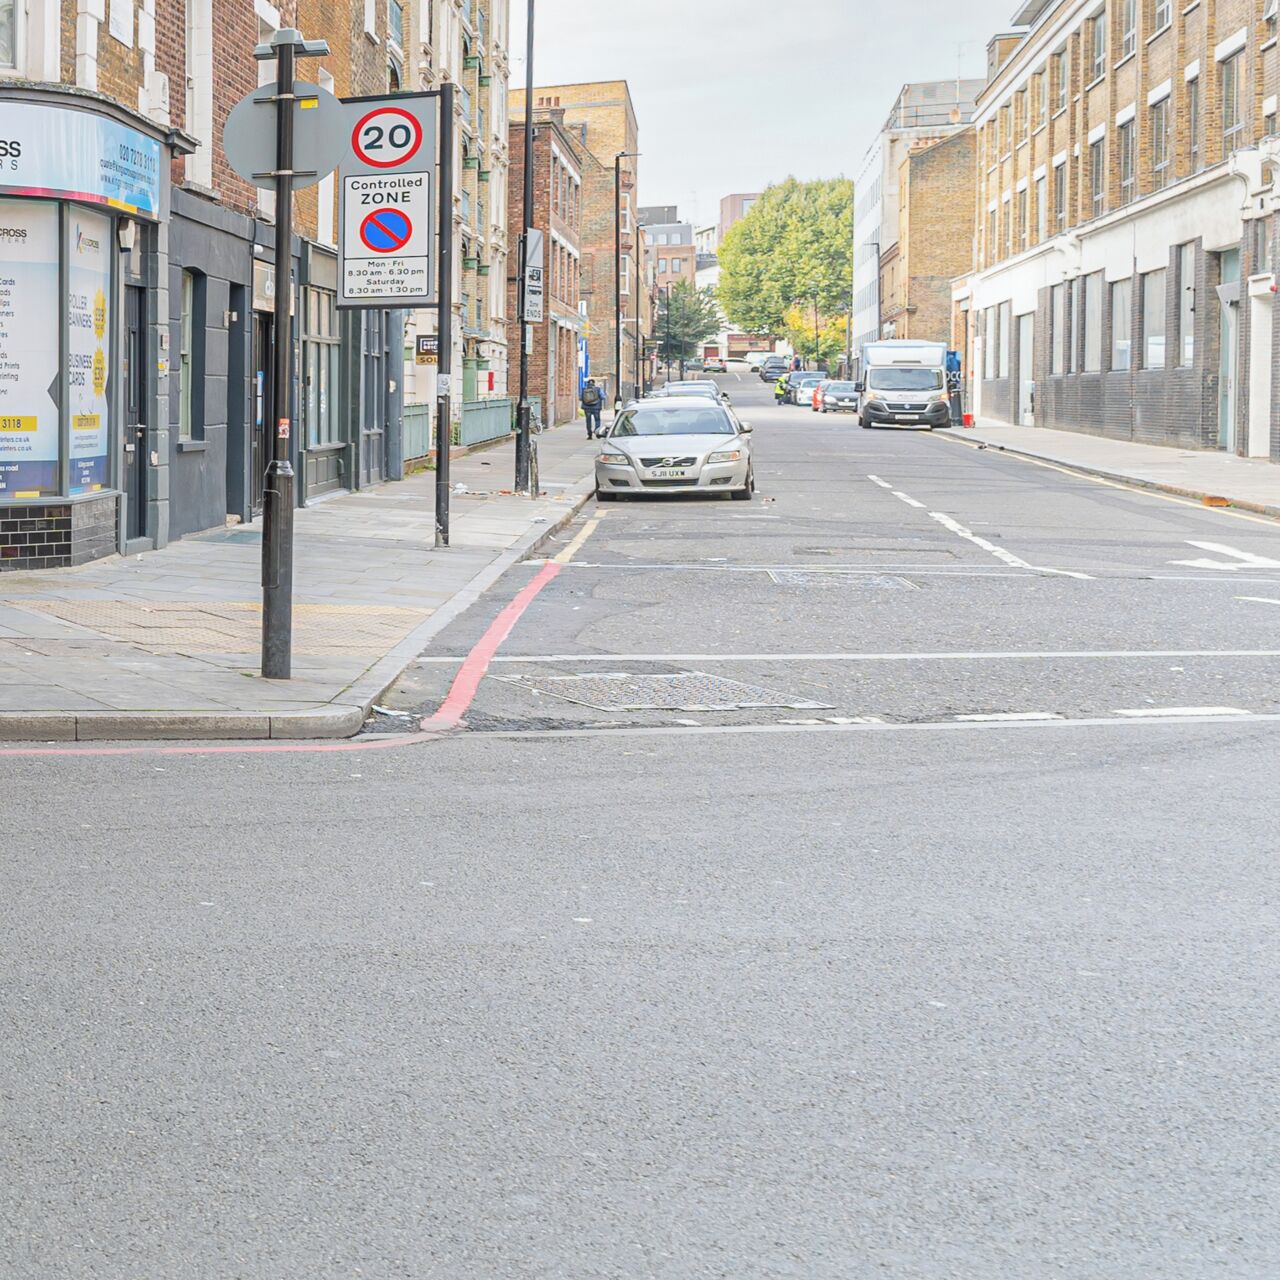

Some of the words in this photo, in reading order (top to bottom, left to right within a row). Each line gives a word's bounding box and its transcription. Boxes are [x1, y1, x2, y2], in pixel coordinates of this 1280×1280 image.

[363, 124, 411, 150] 20
[351, 177, 422, 190] Controlled
[361, 192, 411, 204] ZONE
[388, 268, 410, 276] 6.30
[366, 278, 405, 286] Saturday
[410, 287, 423, 295] pm
[526, 309, 541, 318] ENDS
[4, 362, 20, 370] Prints
[2, 419, 22, 429] 3118
[6, 464, 19, 472] road
